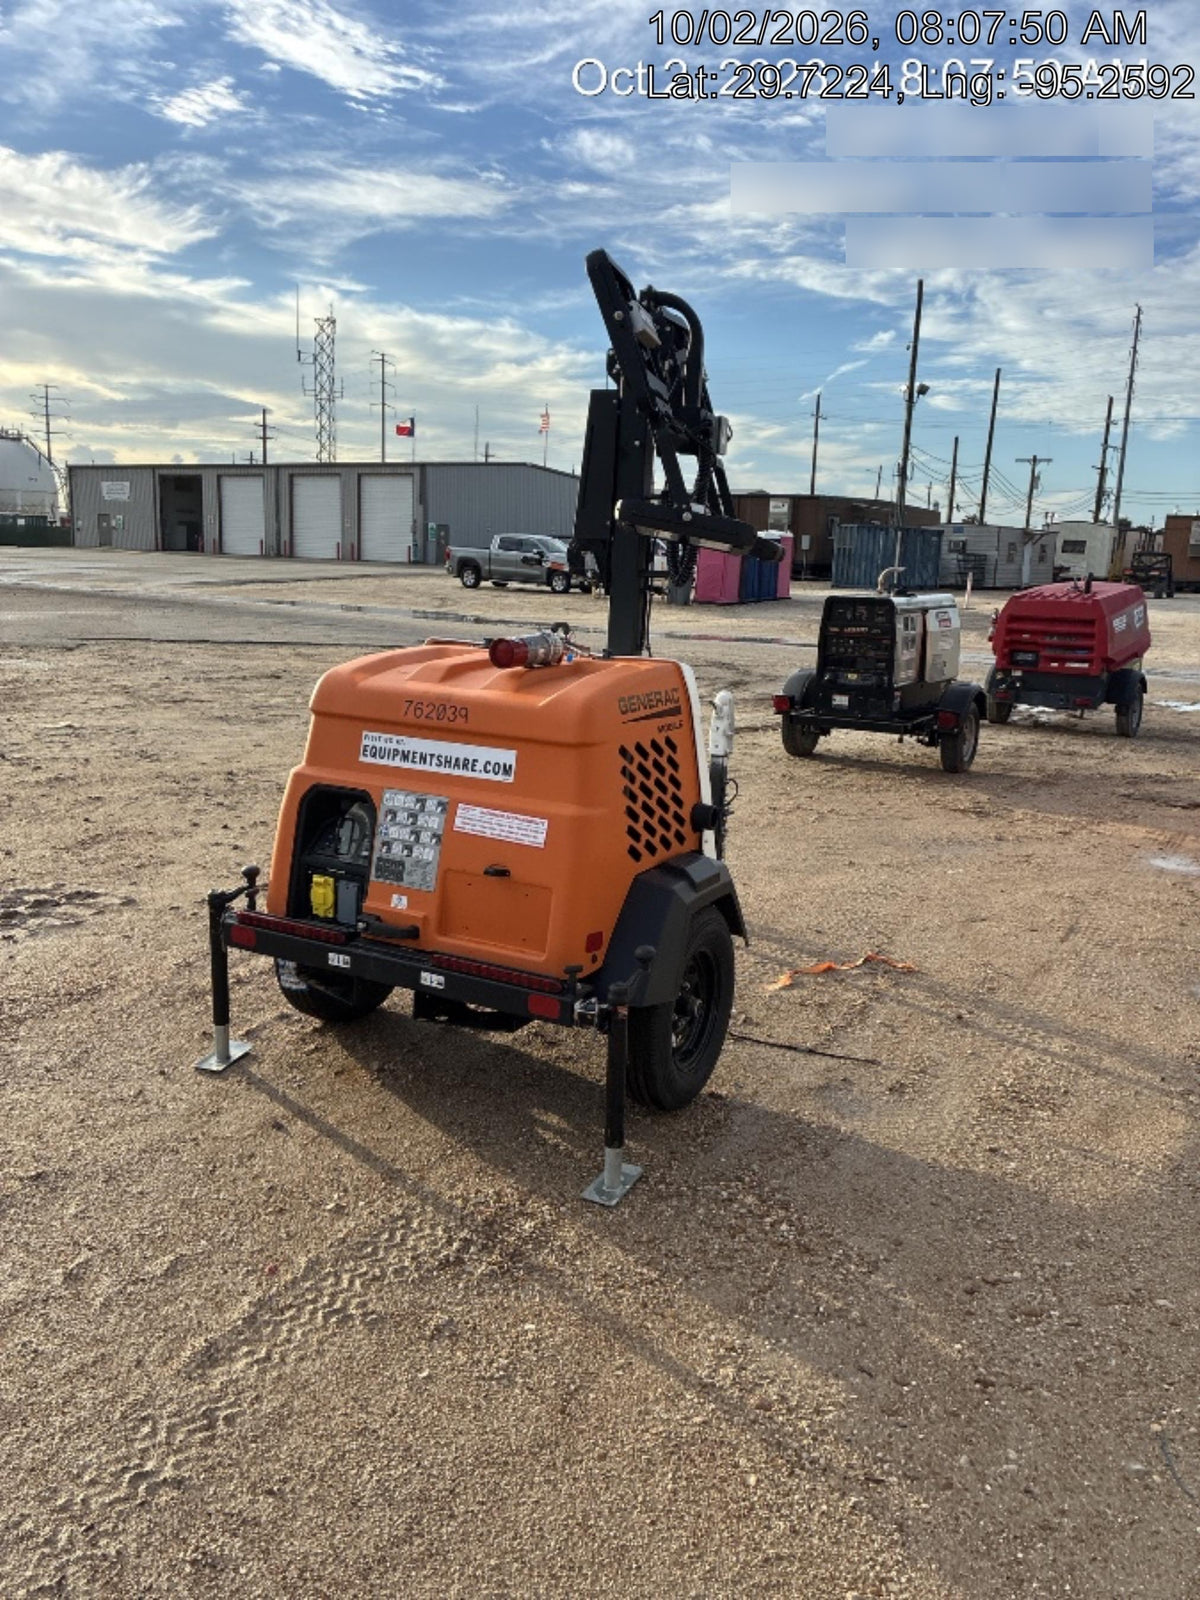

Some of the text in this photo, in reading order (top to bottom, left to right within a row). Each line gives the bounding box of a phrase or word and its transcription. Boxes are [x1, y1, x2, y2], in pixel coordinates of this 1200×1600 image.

[403, 700, 469, 723] 762039
[618, 688, 680, 715] GENERAC
[362, 744, 513, 778] EQUIPMENTSHARE.COM
